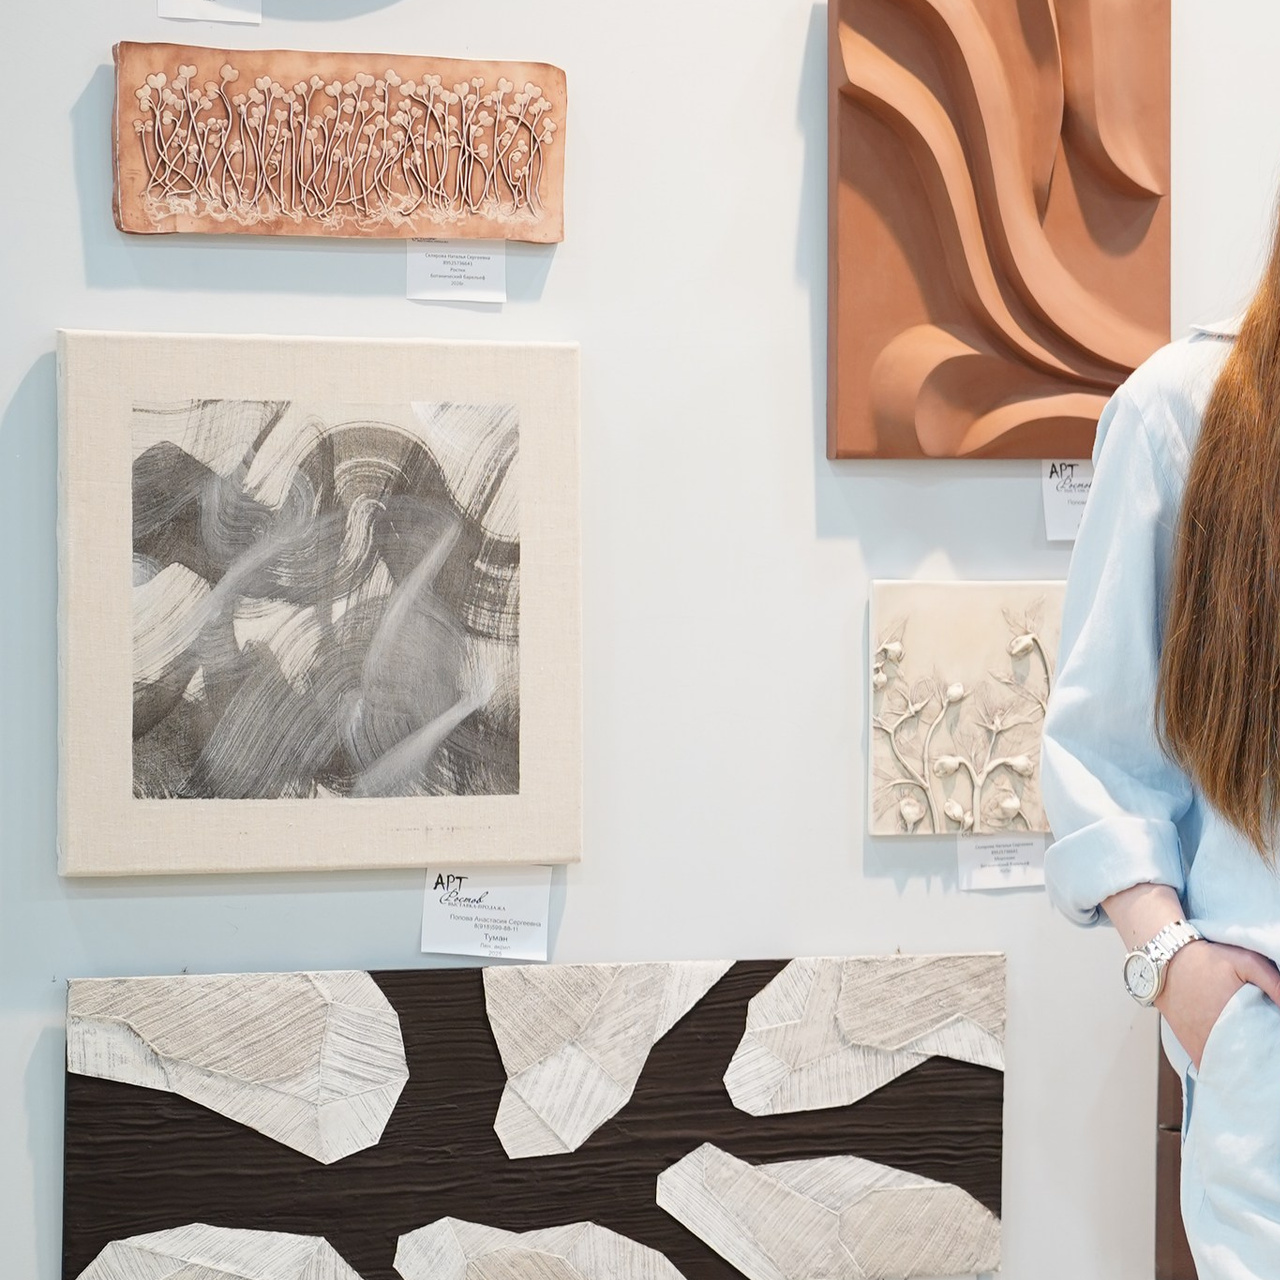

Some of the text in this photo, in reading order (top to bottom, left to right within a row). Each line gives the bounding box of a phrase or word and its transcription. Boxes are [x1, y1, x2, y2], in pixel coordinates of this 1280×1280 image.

[1049, 462, 1080, 480] АРТ
[433, 873, 469, 891] АРТ
[439, 888, 489, 905] Ростов
[450, 914, 542, 927] Попова Анастасия Сергеевна
[484, 932, 508, 943] Туман
